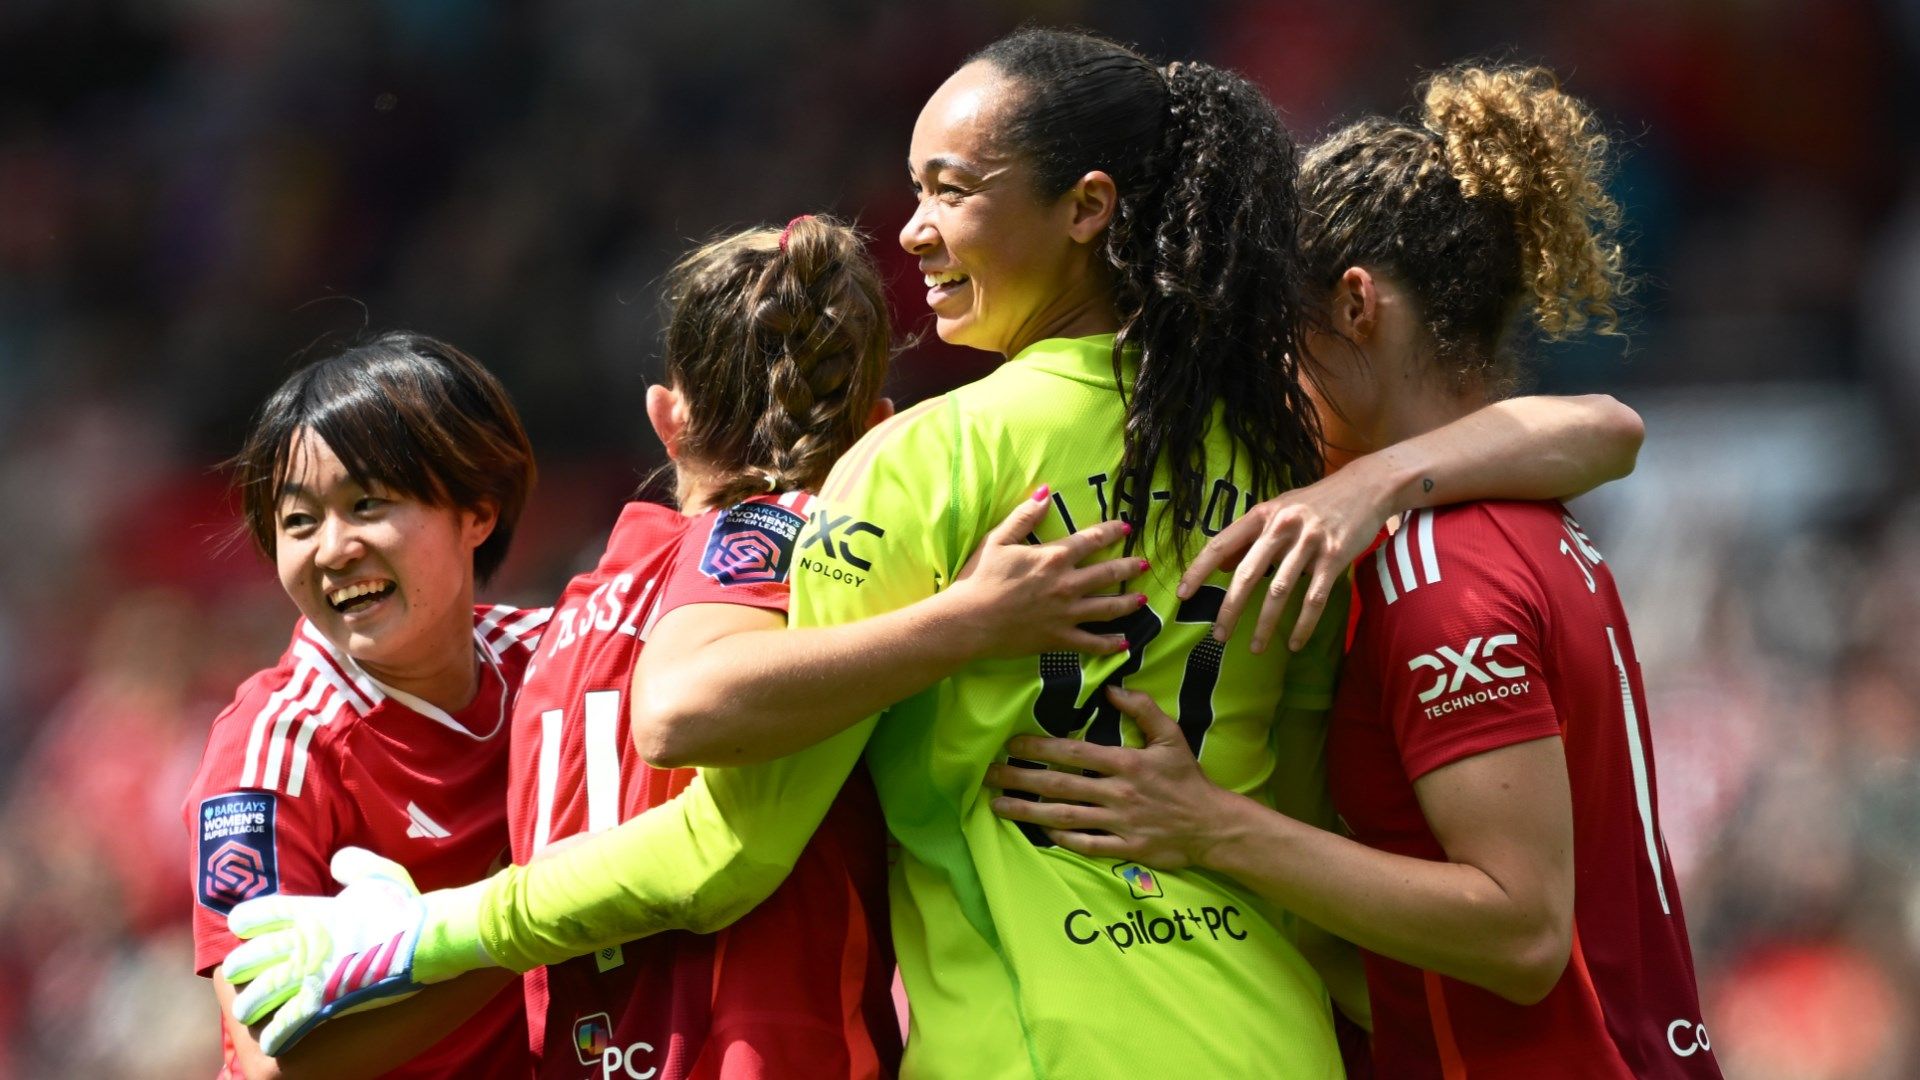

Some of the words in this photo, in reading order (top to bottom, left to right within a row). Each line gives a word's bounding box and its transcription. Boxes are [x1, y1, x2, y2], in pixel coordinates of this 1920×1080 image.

[726, 517, 758, 527] SUPER
[758, 521, 795, 541] LEAGUE
[728, 511, 798, 535] WOMEN'S
[749, 506, 800, 528] BARCLAYS
[800, 510, 885, 572] XC
[800, 557, 865, 588] NOLOGY
[1424, 681, 1530, 720] TECHNOLOGY
[214, 801, 266, 817] BARCLAYS
[204, 812, 265, 832] WOMEN'S
[204, 828, 228, 841] SUPER
[228, 825, 265, 836] LEAGUE
